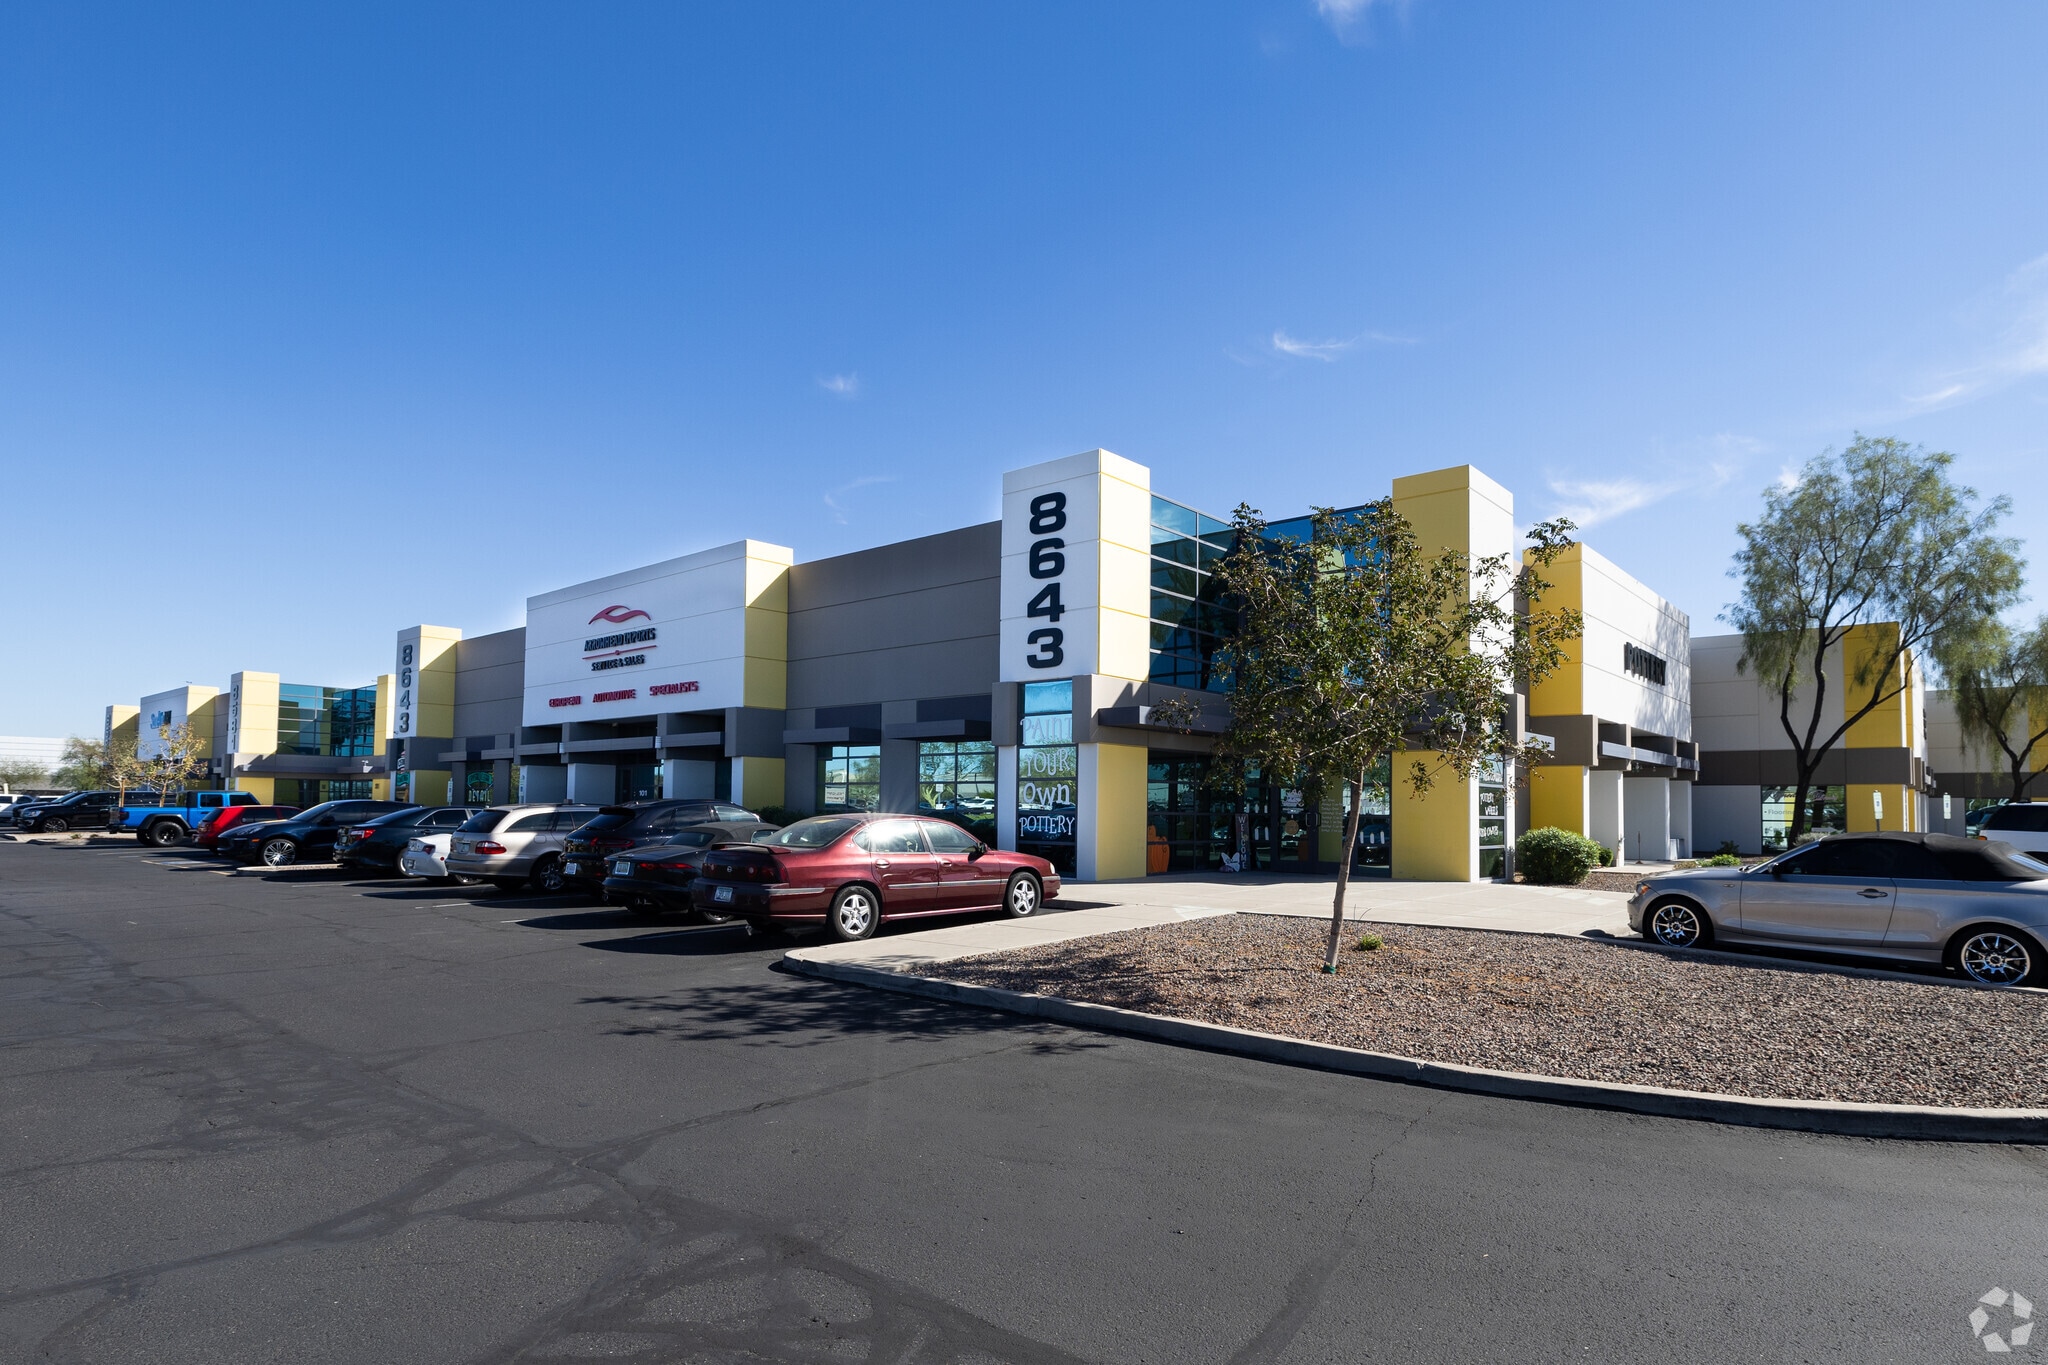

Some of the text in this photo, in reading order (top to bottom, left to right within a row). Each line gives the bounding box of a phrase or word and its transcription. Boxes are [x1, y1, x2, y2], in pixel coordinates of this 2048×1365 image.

[1027, 491, 1067, 669] 8643
[583, 627, 657, 651] ARROWHEAD IMPORTS
[591, 658, 618, 672] SERVICE
[624, 654, 646, 667] SALES
[1623, 641, 1667, 687] POTTERY
[399, 644, 413, 733] 8643
[549, 680, 699, 708] EUROPEAN AUTOMOTIVE SPECIALISTS
[1024, 747, 1071, 777] YOUR
[638, 789, 648, 797] 101
[1018, 814, 1076, 837] POTTERY
[1238, 815, 1247, 870] WELCOME
